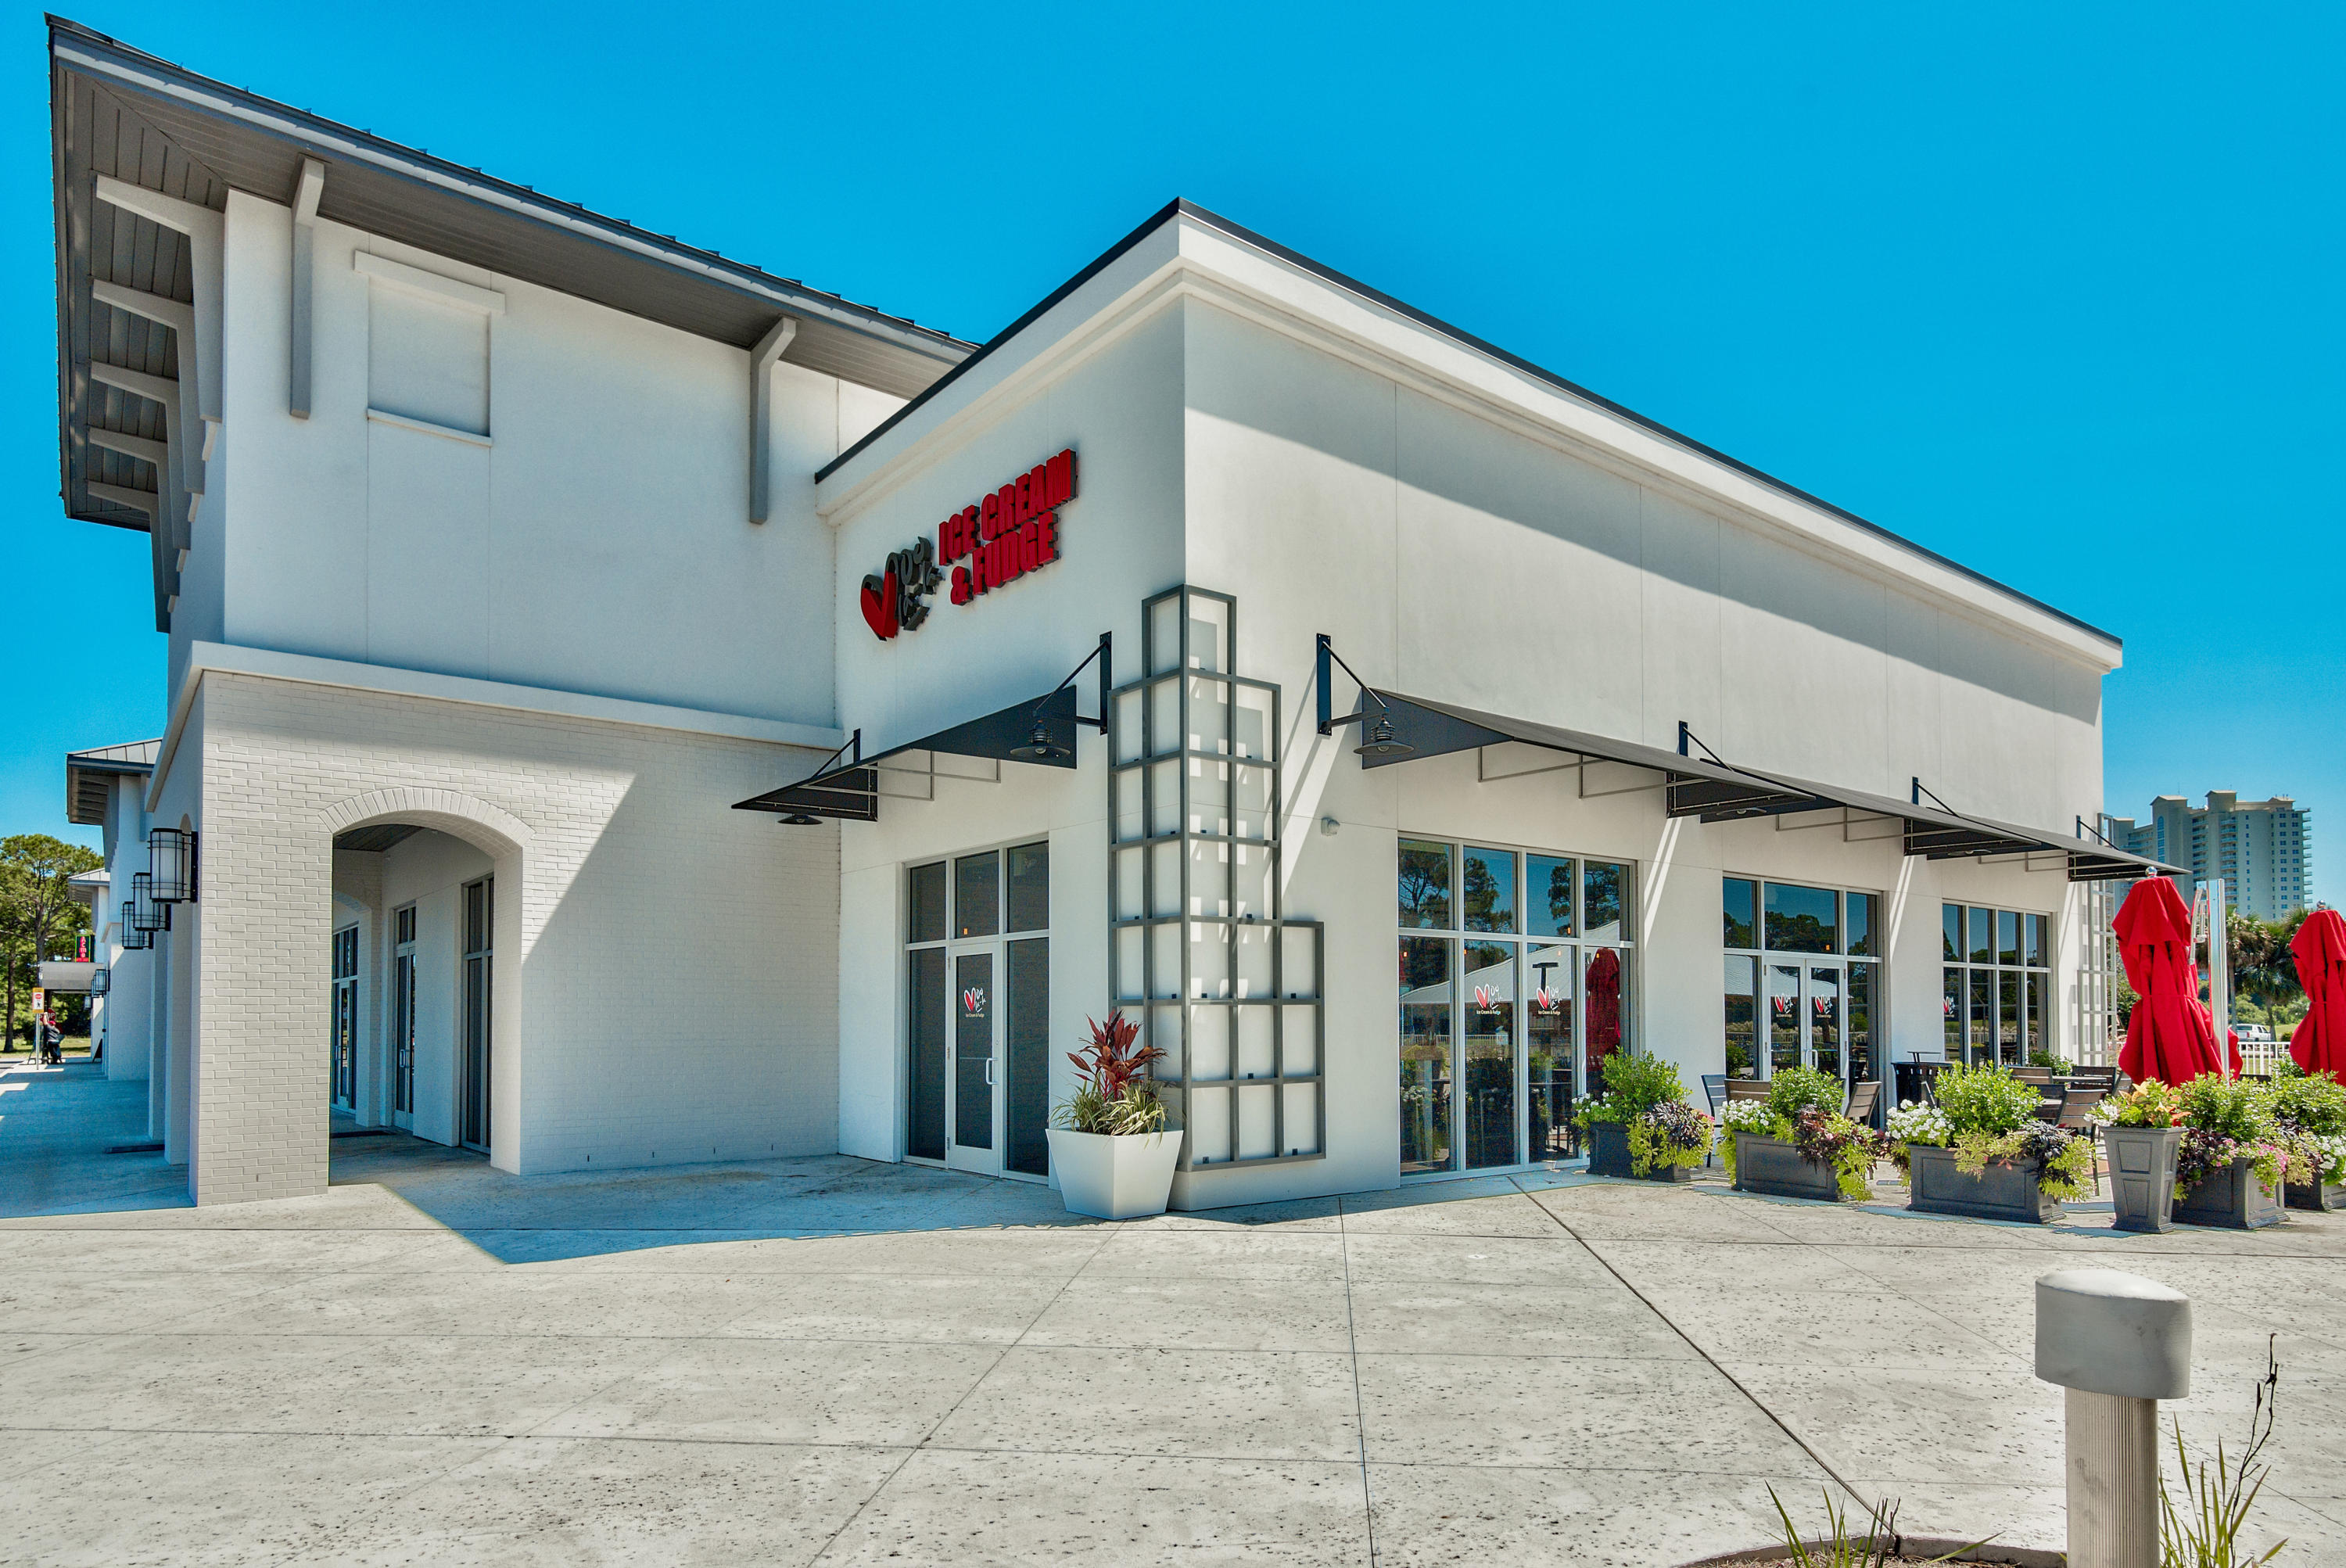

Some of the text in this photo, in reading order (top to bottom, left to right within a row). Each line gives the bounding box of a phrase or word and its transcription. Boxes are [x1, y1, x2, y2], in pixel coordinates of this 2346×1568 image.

[938, 448, 1077, 567] ICE CREAM
[950, 511, 1059, 607] & FUDGE
